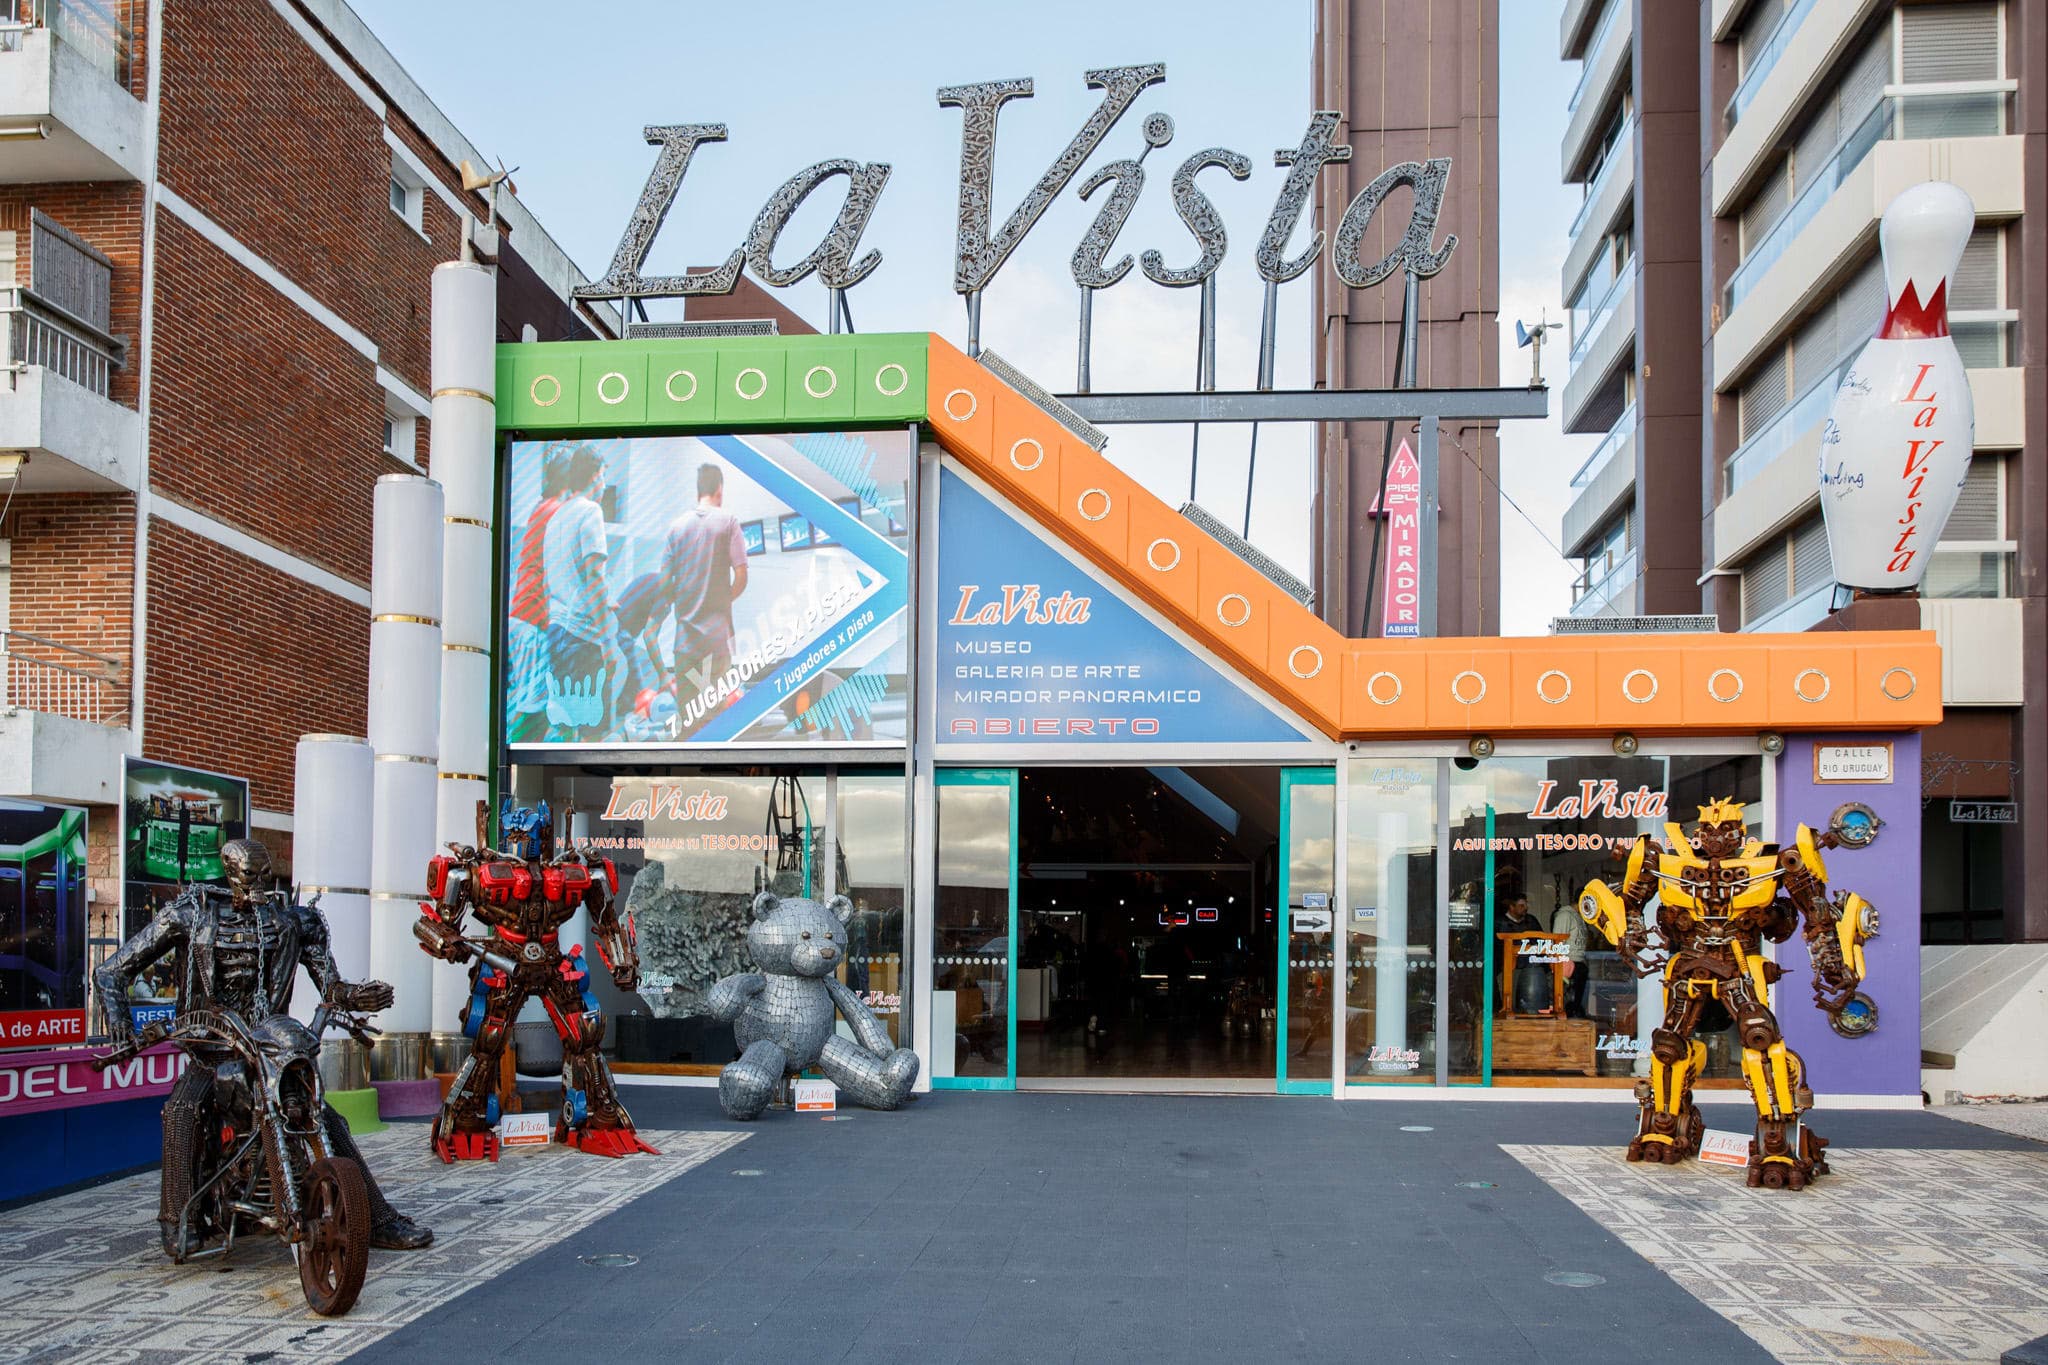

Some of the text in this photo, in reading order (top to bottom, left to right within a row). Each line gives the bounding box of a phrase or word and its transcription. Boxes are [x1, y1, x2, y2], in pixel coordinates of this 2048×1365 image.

[573, 62, 1459, 299] La Vista
[1887, 364, 1944, 573] La Vista
[1394, 513, 1417, 621] MIRADOR
[949, 584, 1093, 626] LaVista
[774, 609, 875, 694] 7 jugadores x pista
[955, 641, 1032, 654] MUSEO
[955, 665, 1141, 678] GALERIA DE ARTE
[666, 717, 681, 739] 7
[682, 633, 788, 728] JUGADORES
[954, 690, 1201, 703] MIRADOR PANORAMICO
[950, 718, 1160, 735] ABIERTO
[1834, 749, 1873, 757] CALLE
[1823, 764, 1883, 773] RIO URUGUAY
[601, 783, 729, 821] LaVista
[1527, 779, 1669, 820] LaVista
[590, 837, 624, 849] VAYAS
[627, 837, 646, 849] SIN
[701, 834, 779, 850] TESORO!!!
[1453, 838, 1486, 851] AQUI
[1488, 838, 1517, 850] ESTA
[1518, 838, 1534, 850] TU
[1536, 833, 1604, 851] TESORO
[1605, 838, 1613, 850] Y
[136, 1009, 175, 1022] REST
[11, 1021, 32, 1038] de
[37, 1018, 81, 1037] ARTE
[1368, 1046, 1420, 1061] LaVista
